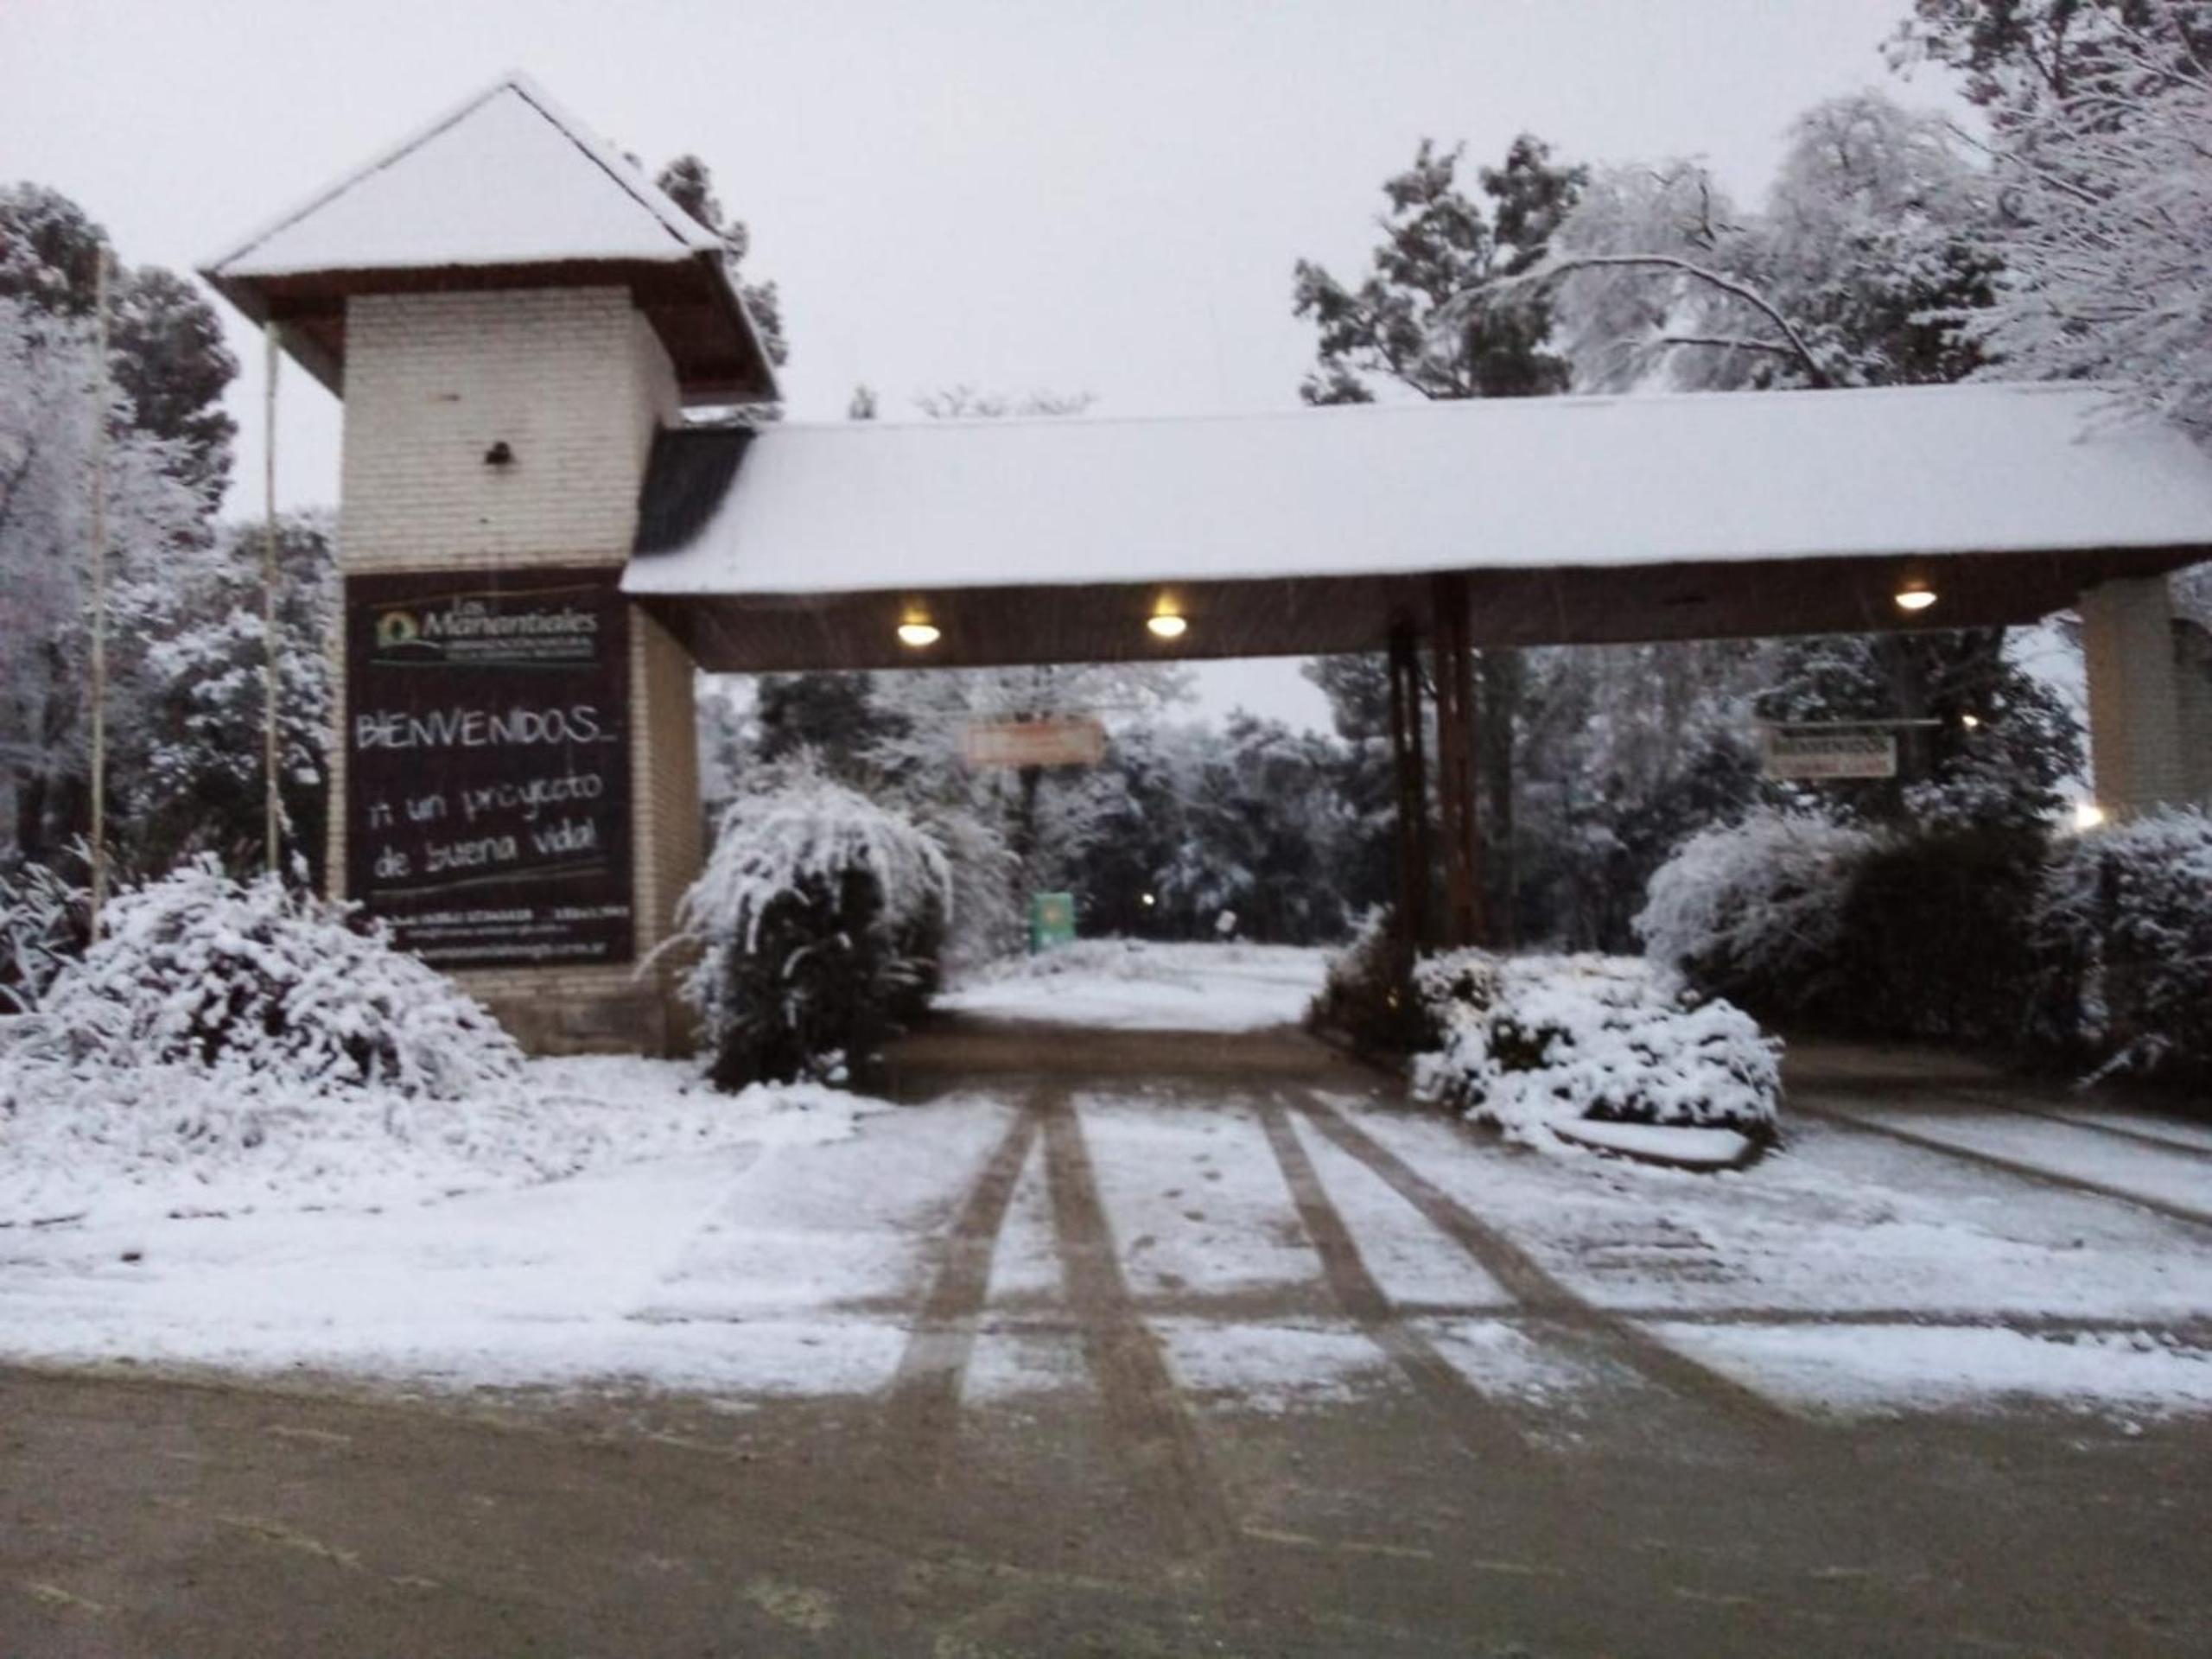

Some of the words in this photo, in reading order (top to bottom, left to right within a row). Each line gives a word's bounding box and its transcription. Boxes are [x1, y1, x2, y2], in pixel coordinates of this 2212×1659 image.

[422, 607, 598, 638] Manantiales
[405, 793, 448, 821] un
[373, 845, 410, 879] de
[424, 835, 518, 873] buena
